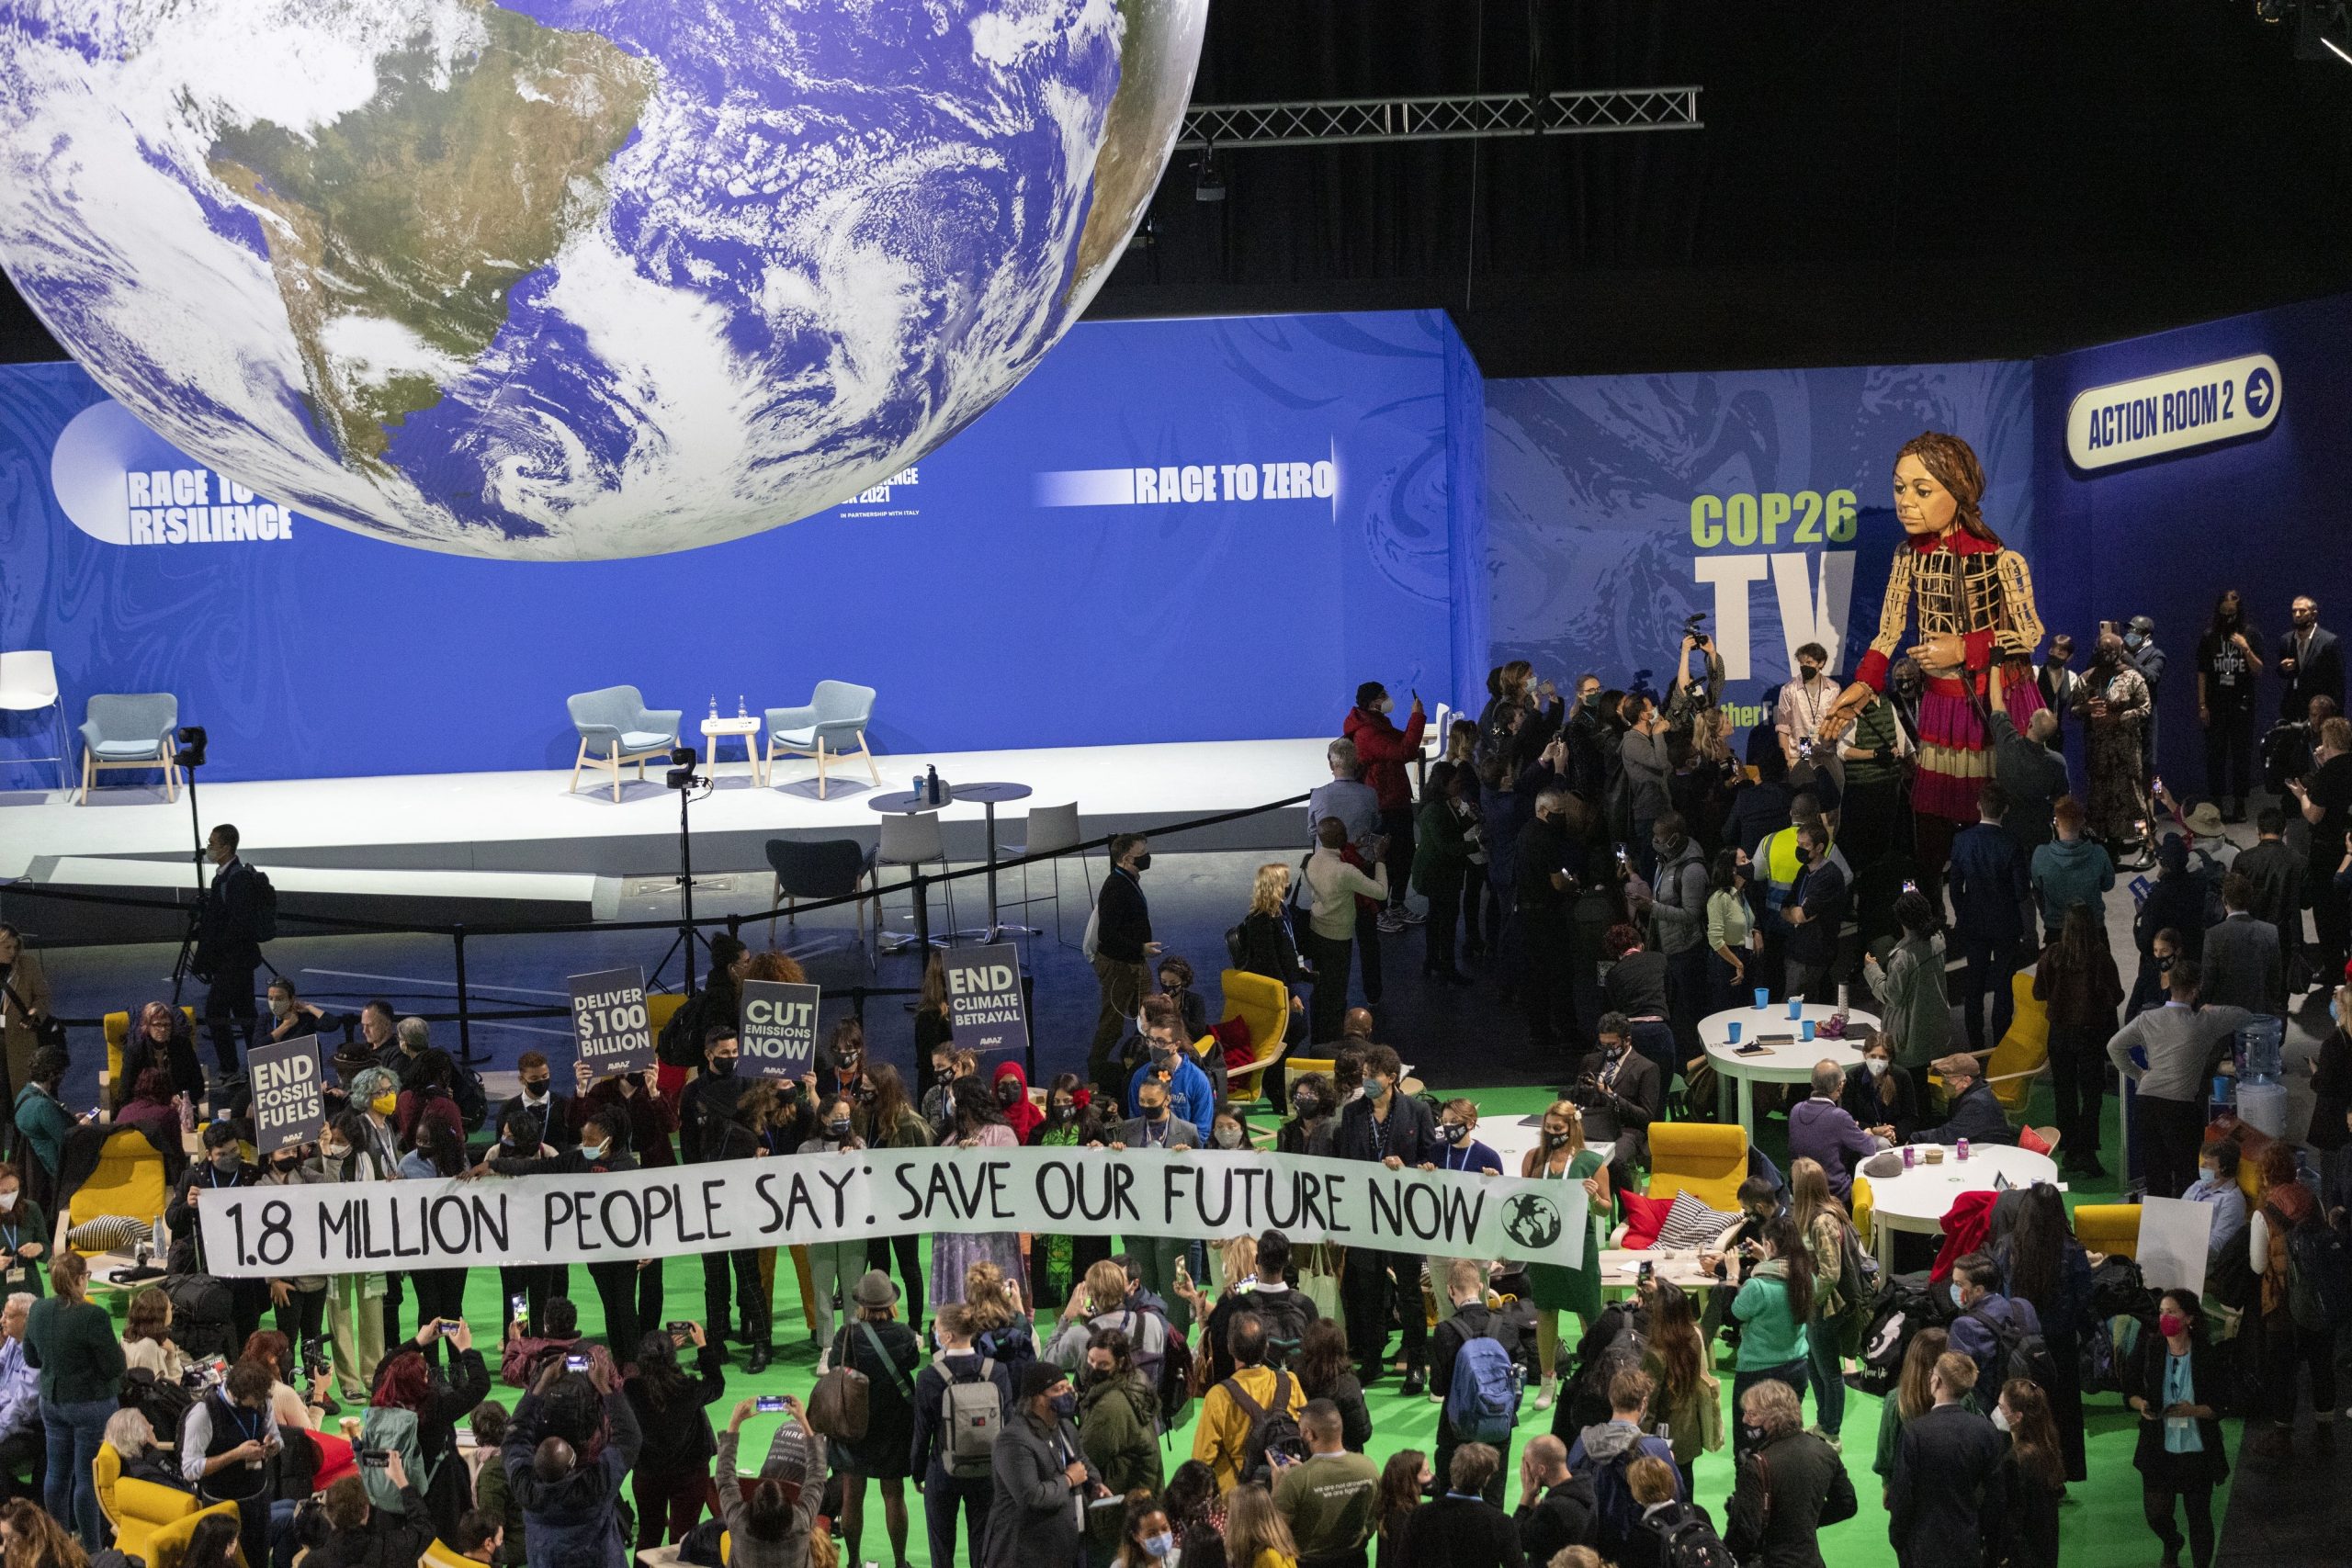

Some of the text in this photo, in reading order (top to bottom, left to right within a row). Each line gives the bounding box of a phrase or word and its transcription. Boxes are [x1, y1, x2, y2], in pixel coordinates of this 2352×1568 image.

[2088, 379, 2234, 451] ACTION ROOM 2
[128, 469, 209, 507] RACE
[1136, 460, 1334, 503] RACE TO ZERO
[130, 504, 293, 546] RESILIENCE
[1690, 489, 1858, 548] COP26
[1695, 550, 1857, 681] TV
[949, 965, 1013, 994] END
[574, 987, 643, 1011] DELIVER
[746, 999, 813, 1026] CUT
[953, 993, 1019, 1011] CLIMATE
[578, 1004, 647, 1039] $100
[745, 1023, 811, 1039] EMISSIONS
[955, 1010, 1021, 1026] BETRAYAL
[581, 1030, 650, 1057] BILLION
[742, 1035, 810, 1060] NOW
[254, 1055, 313, 1091] END
[257, 1080, 318, 1110] FOSSIL
[259, 1099, 320, 1130] FUELS
[226, 1161, 1486, 1266] 1.8 MILLION PEOPLE SAY: SAVE OUR FUTURE NOW
